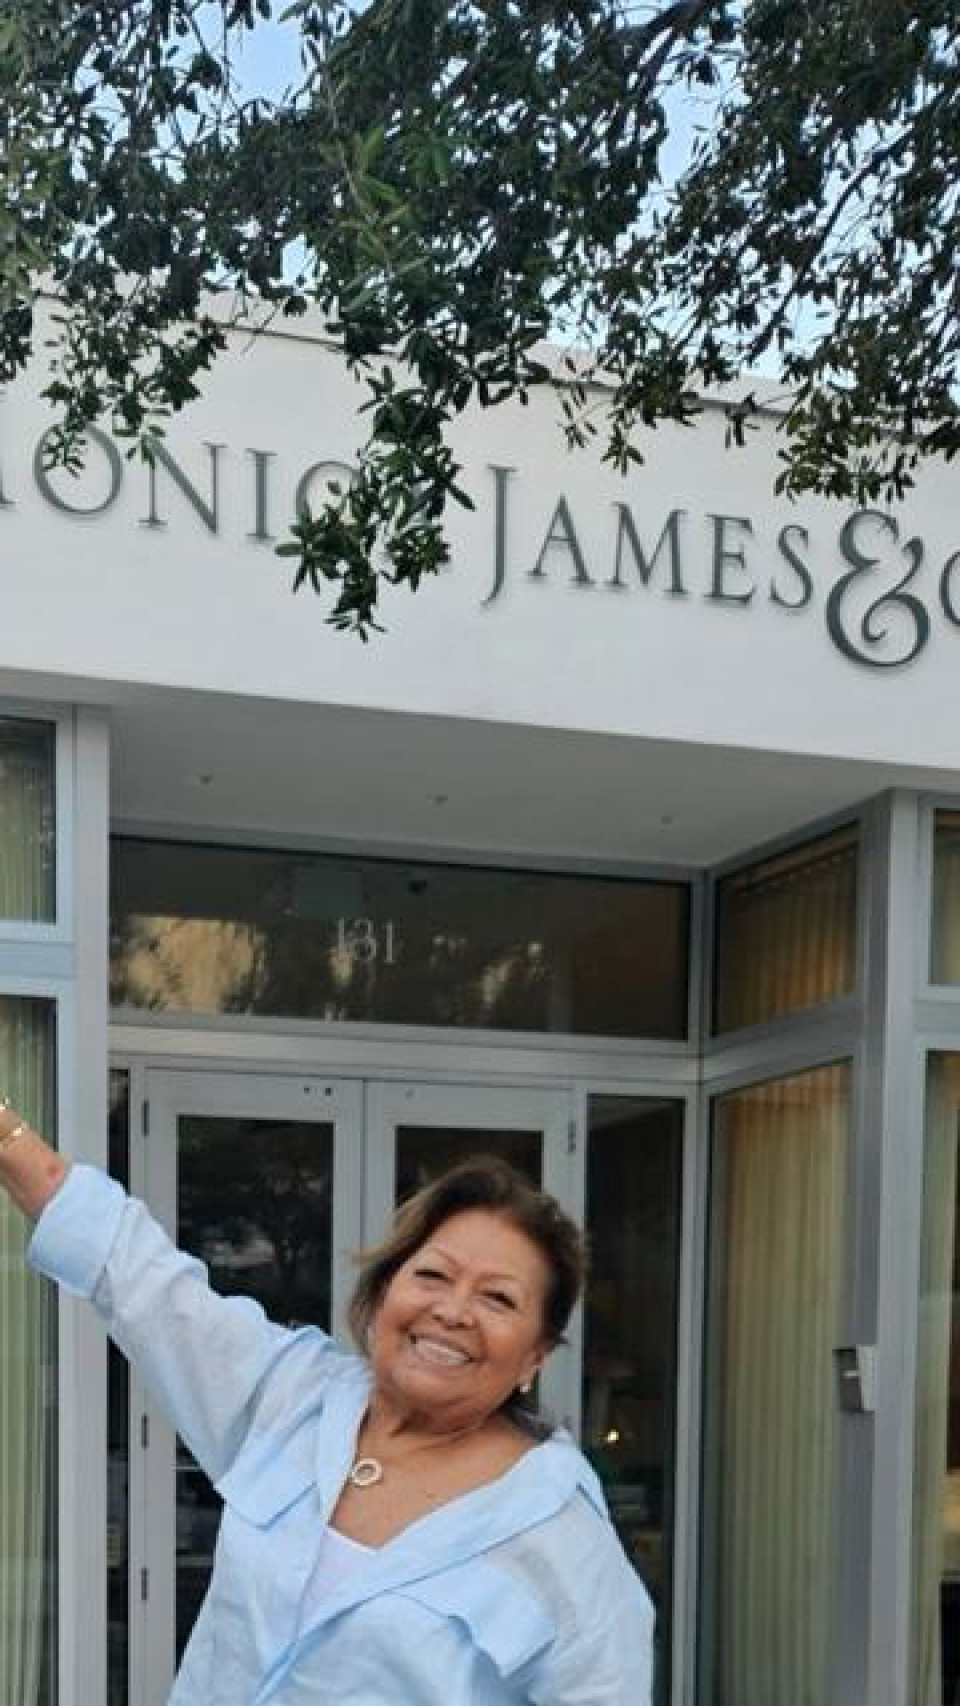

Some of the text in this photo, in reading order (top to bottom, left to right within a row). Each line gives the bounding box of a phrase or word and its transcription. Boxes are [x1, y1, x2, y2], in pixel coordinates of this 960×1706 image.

[481, 464, 813, 609] JAMES
[826, 508, 931, 667] &
[335, 916, 396, 965] 131
